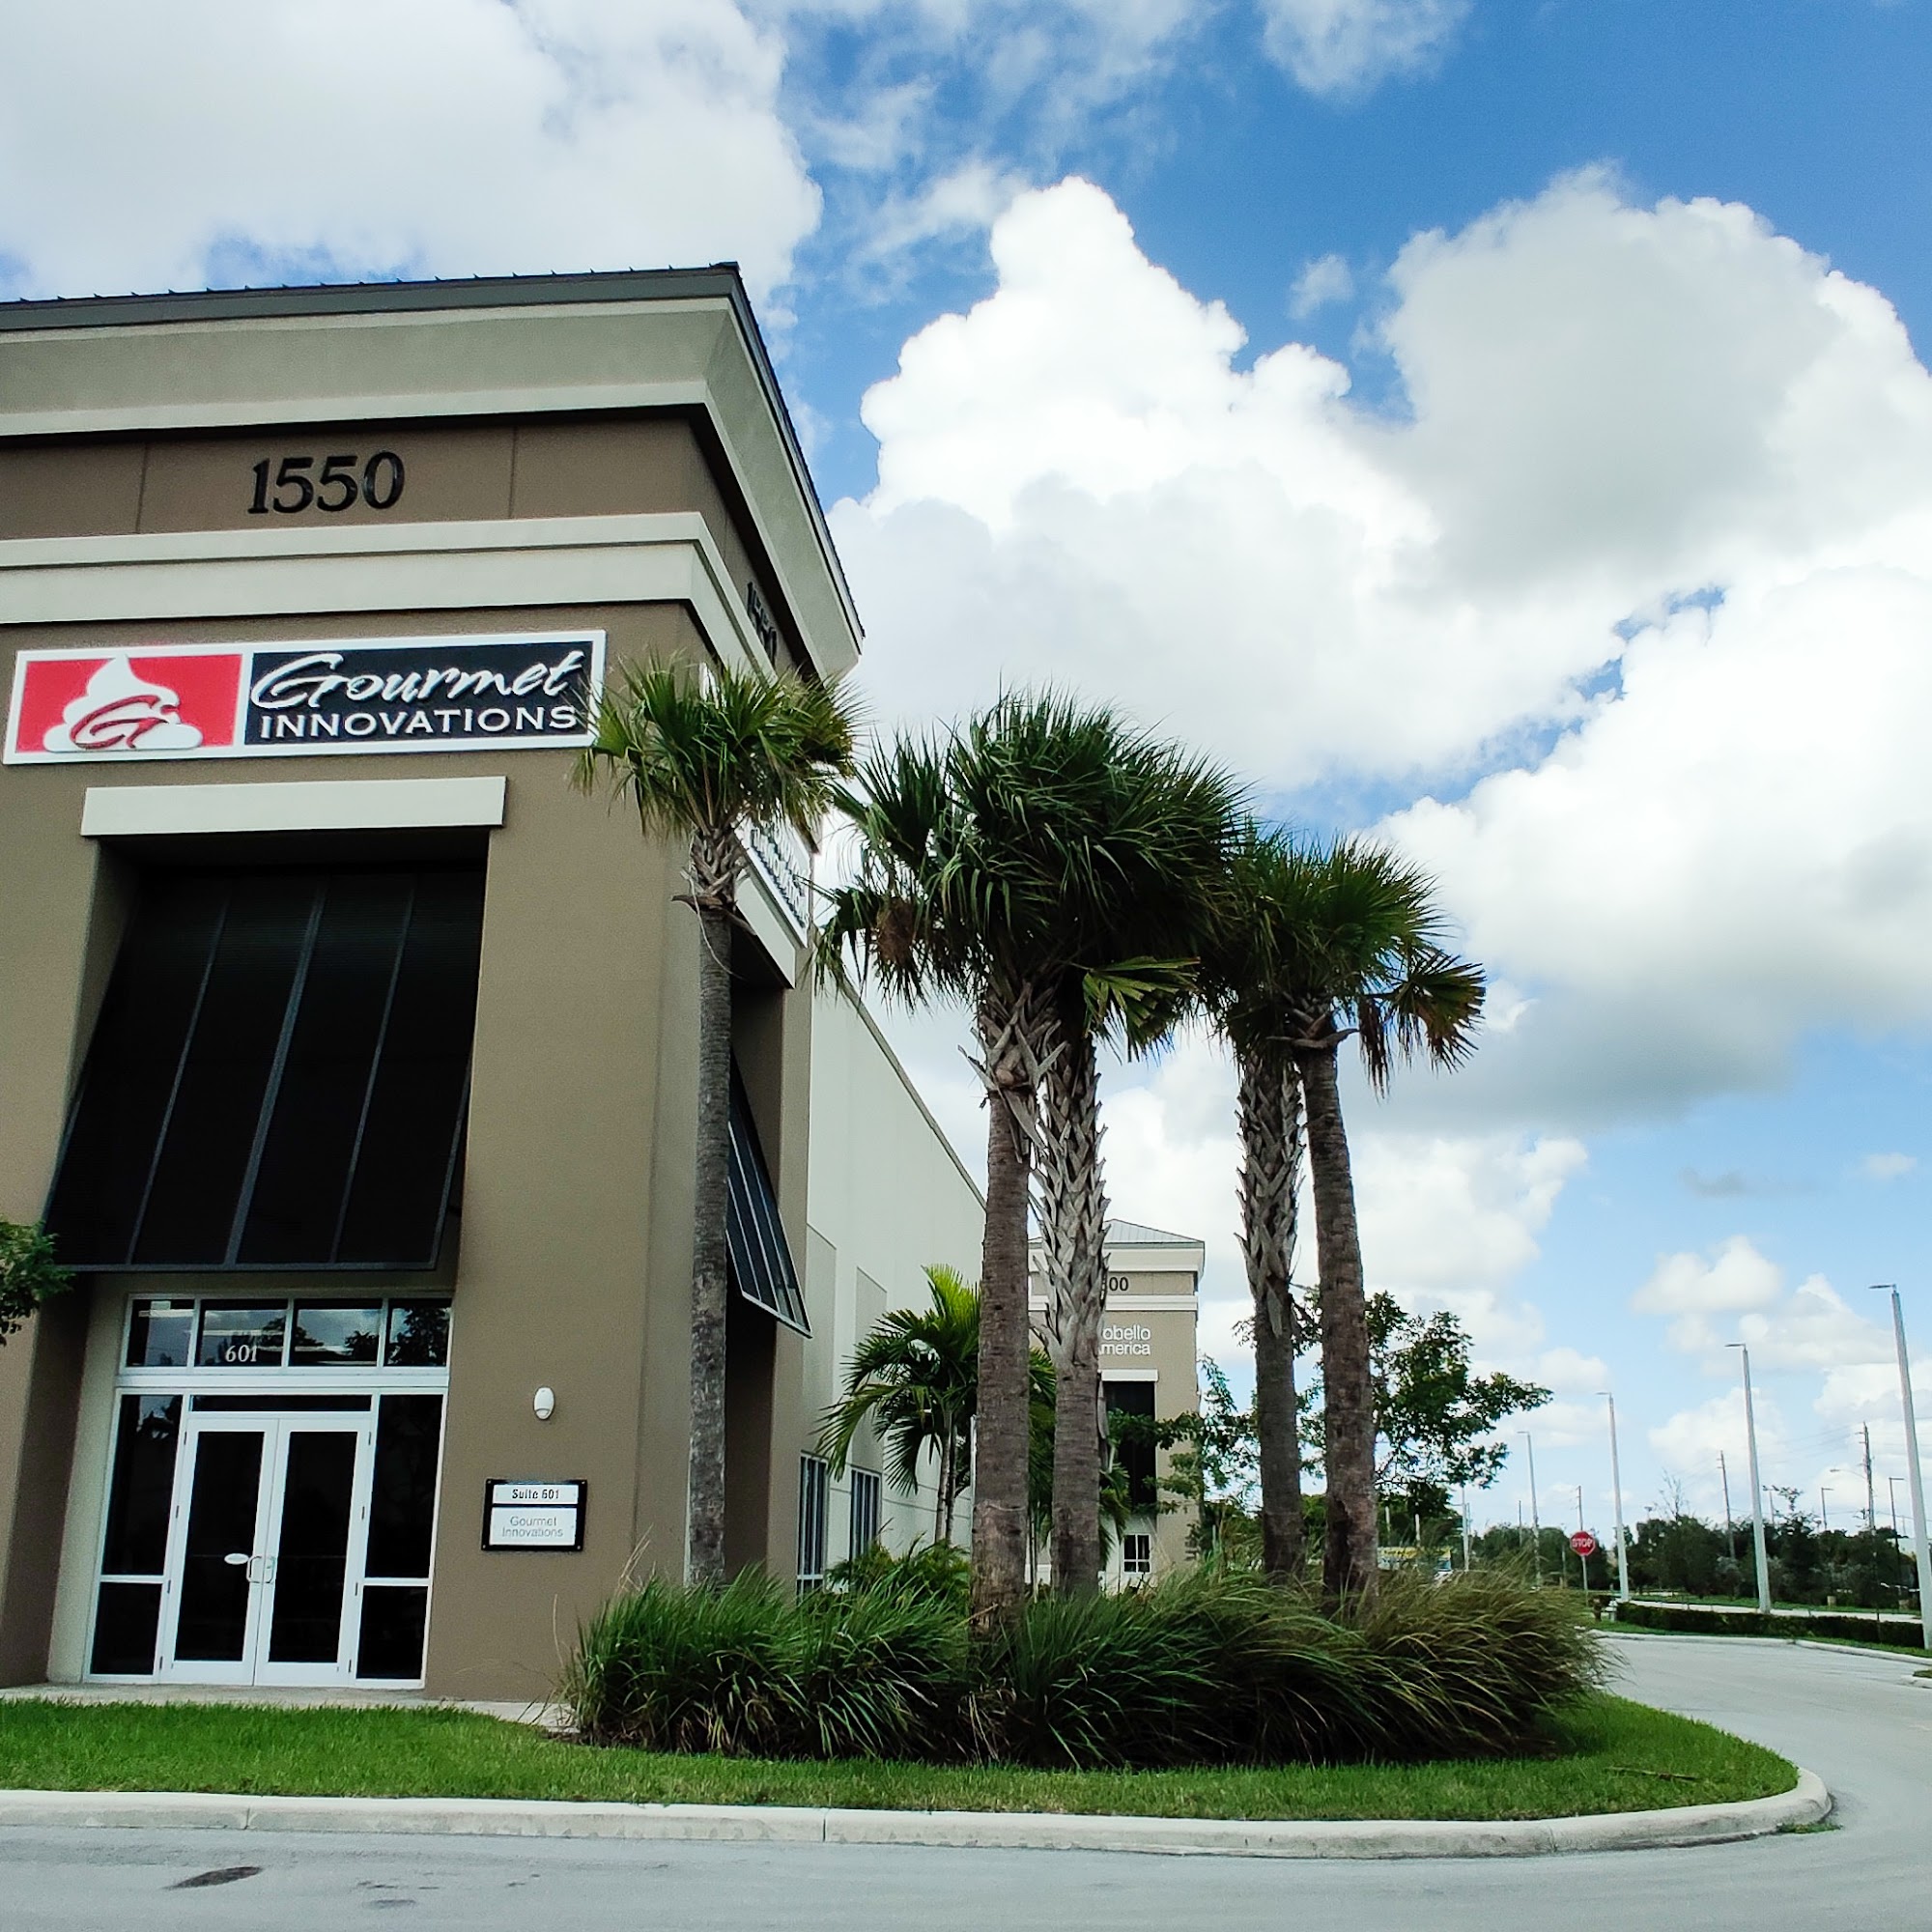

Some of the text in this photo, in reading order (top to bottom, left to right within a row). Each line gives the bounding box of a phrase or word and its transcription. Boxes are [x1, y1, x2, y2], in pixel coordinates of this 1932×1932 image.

[247, 451, 405, 514] 1550
[250, 650, 585, 710] Gourmet
[260, 705, 578, 739] INNOVATIONS
[1108, 1276, 1128, 1292] 00
[1102, 1324, 1151, 1340] obello
[225, 1344, 257, 1362] 601
[1099, 1342, 1151, 1355] merica
[512, 1489, 559, 1499] Suite 601
[510, 1516, 557, 1526] Gourmet
[502, 1527, 563, 1538] Innovations
[1572, 1538, 1593, 1548] STOP
